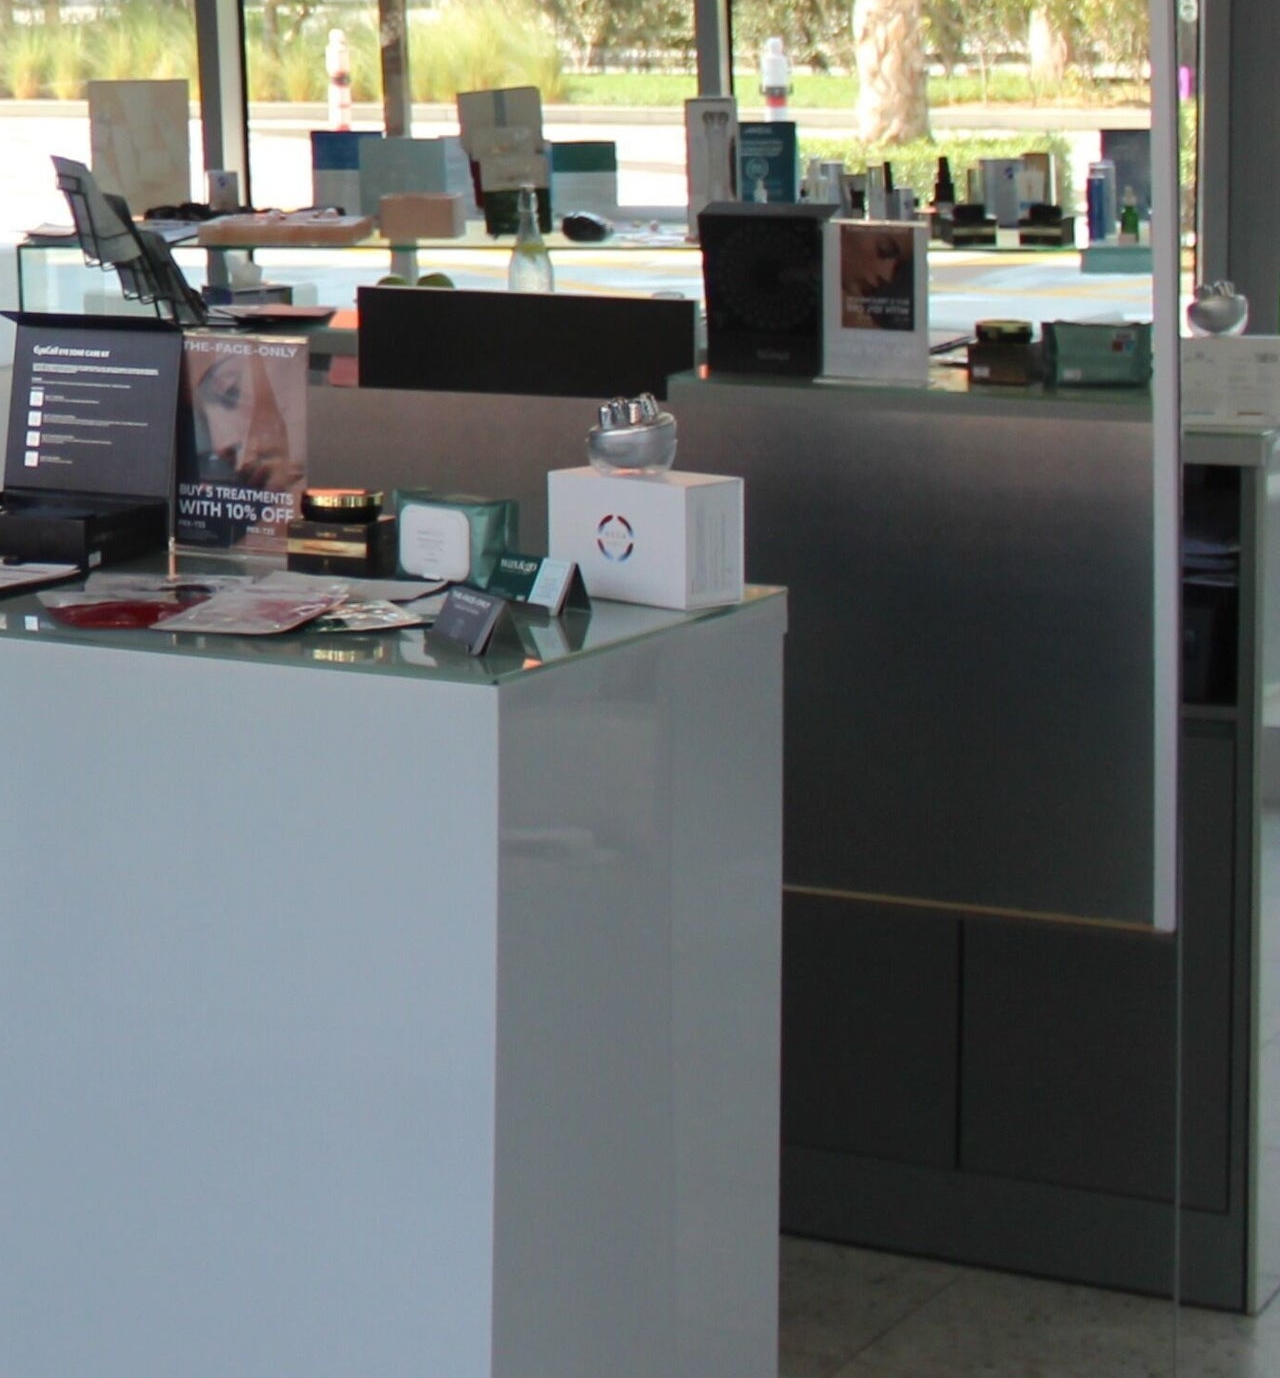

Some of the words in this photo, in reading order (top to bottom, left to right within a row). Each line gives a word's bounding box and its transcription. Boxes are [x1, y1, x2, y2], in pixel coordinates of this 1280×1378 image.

[179, 483, 203, 498] BUY
[205, 485, 214, 498] 5
[215, 487, 294, 506] TREATMENTS
[179, 499, 222, 518] WITH
[225, 503, 258, 521] 10%
[260, 506, 295, 525] OFF
